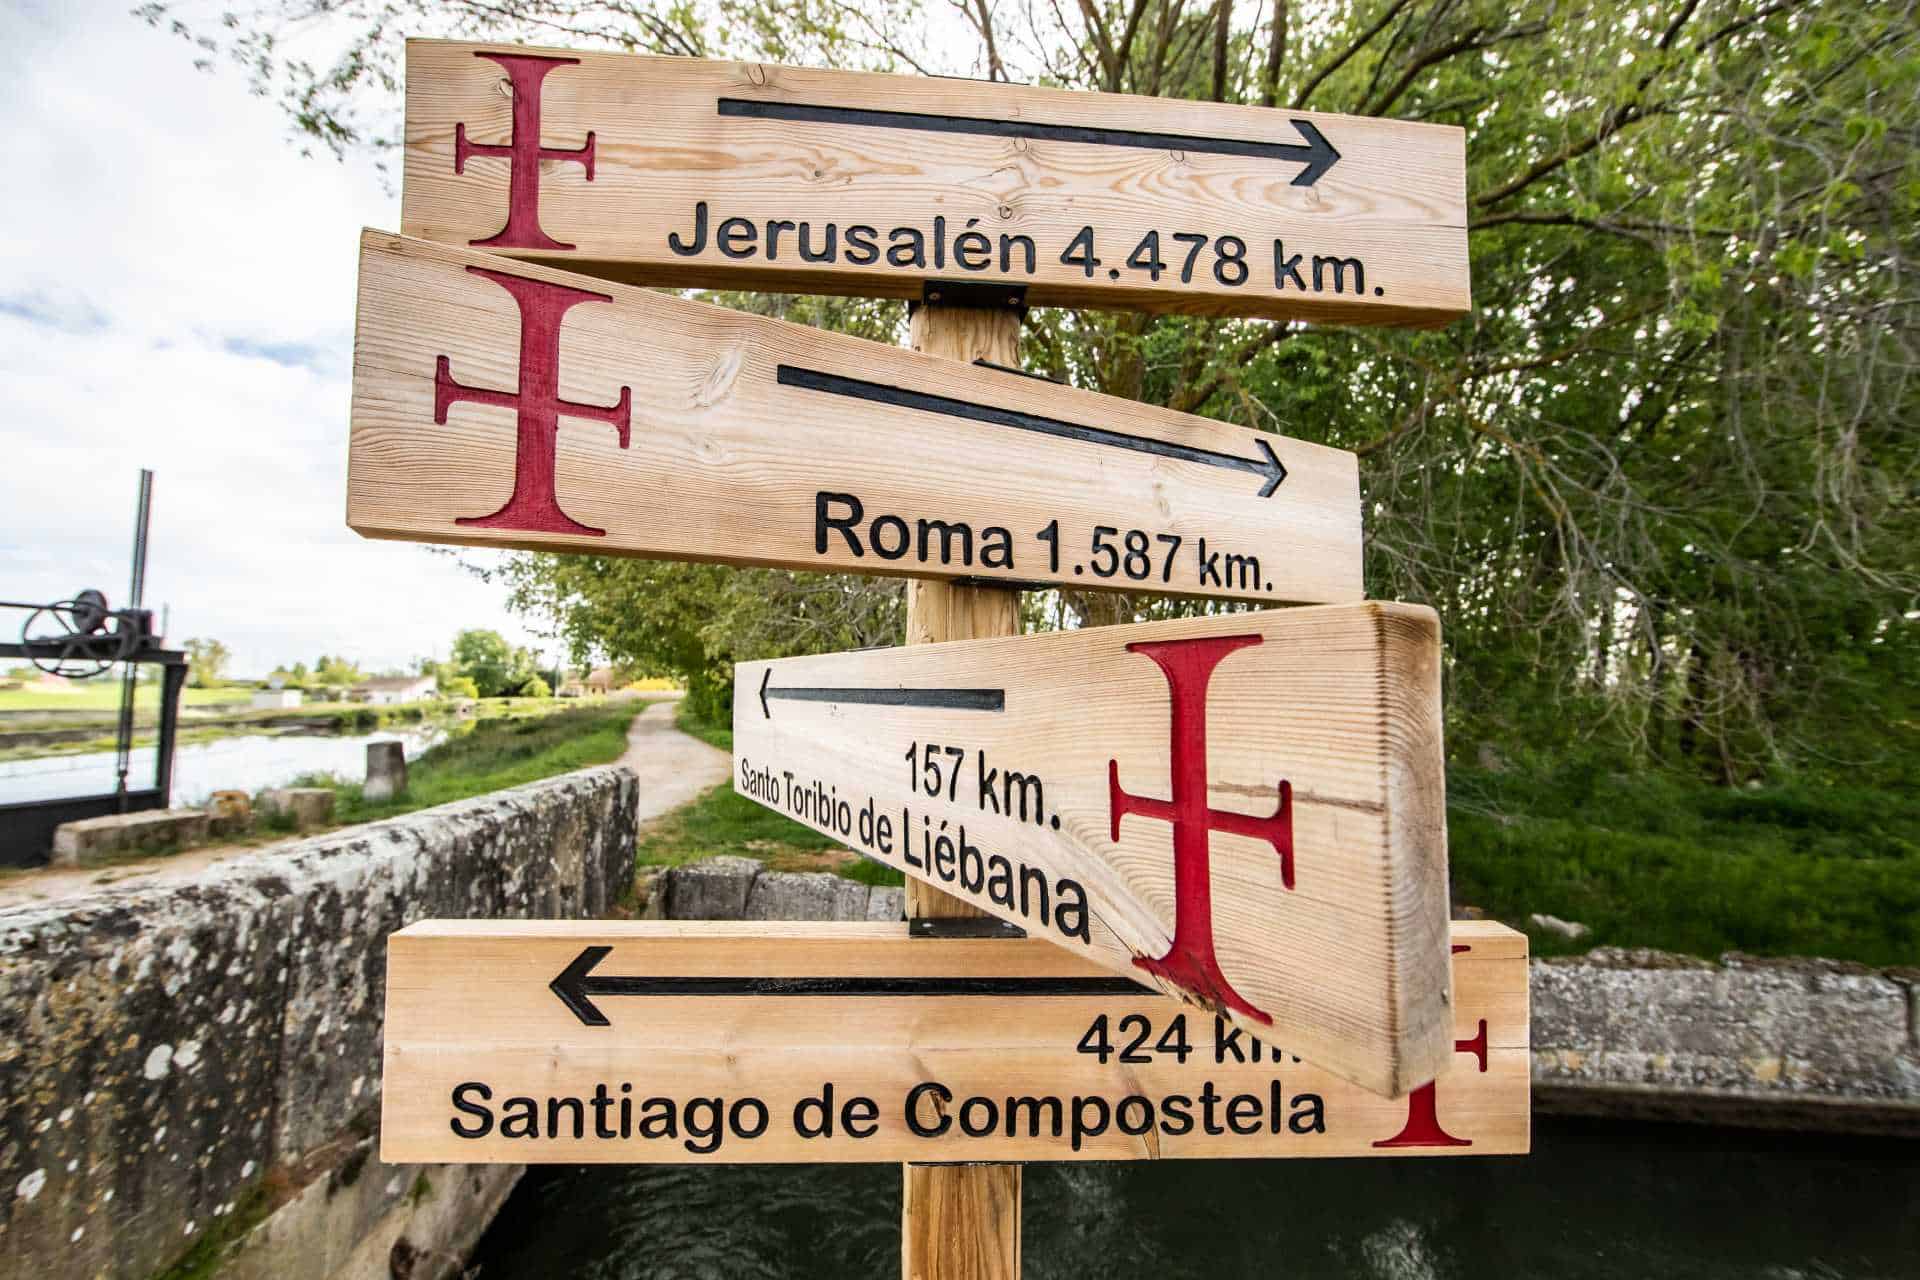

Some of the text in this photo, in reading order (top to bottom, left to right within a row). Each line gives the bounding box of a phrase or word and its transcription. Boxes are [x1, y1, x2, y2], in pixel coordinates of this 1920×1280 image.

[668, 200, 1385, 298] Jerusalén 4.478 km.
[815, 490, 1274, 592] Roma 1.587 km.
[905, 740, 1061, 831] 157 km.
[741, 757, 1091, 946] Santo Toribio de Liébana
[1076, 1013, 1194, 1065] 424
[450, 1079, 1326, 1154] Santiago de Compostela
